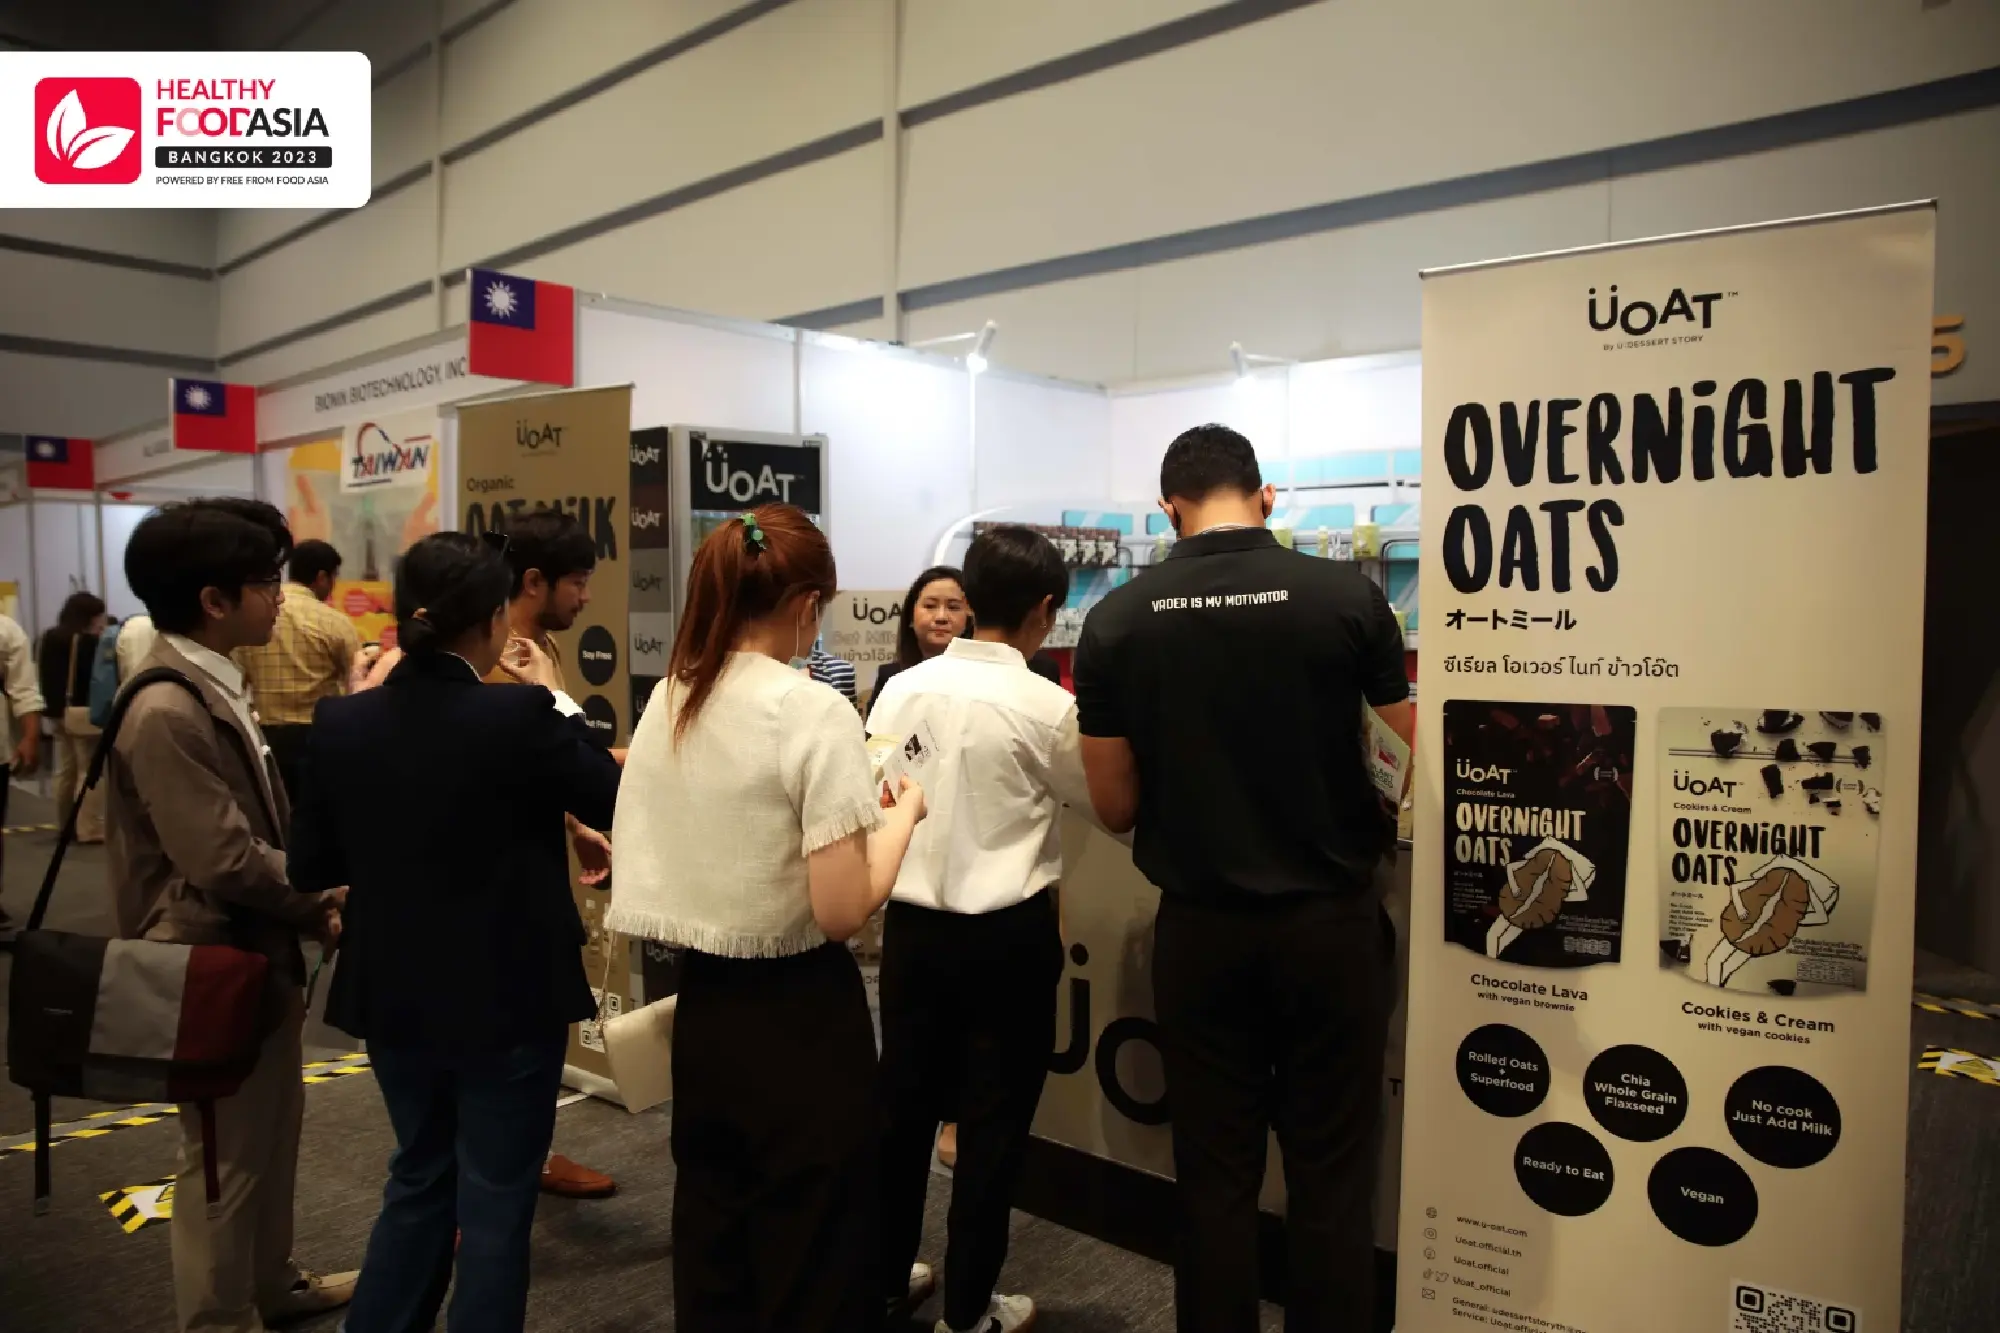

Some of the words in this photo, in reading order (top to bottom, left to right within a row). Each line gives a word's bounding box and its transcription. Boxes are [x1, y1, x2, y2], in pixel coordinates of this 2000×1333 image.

[1588, 284, 1723, 336] ÜOAT
[1602, 343, 1614, 351] By
[1672, 335, 1704, 345] STORY
[466, 476, 515, 493] Organic
[705, 451, 795, 503] ÜOAT
[1443, 498, 1624, 594] OATS
[852, 597, 902, 624] ÜOA
[1152, 597, 1188, 612] VADER
[1191, 597, 1203, 609] IS
[1206, 595, 1222, 608] MY
[1224, 589, 1289, 607] MOTIVATOR
[1445, 609, 1577, 630] オートミール
[1456, 788, 1495, 798] Chocolate
[1673, 769, 1737, 798] ÜOAT
[1673, 802, 1710, 812] Cookies
[1721, 805, 1752, 814] Cream
[1455, 834, 1512, 867] OATS
[1672, 852, 1737, 886] OATS
[1470, 973, 1547, 995] Chocolate
[1551, 984, 1588, 1001] Lava
[1477, 991, 1498, 1001] with
[1500, 993, 1531, 1006] vegan
[1533, 999, 1575, 1012] brownie
[1681, 1001, 1751, 1022] Cookies
[1756, 1011, 1768, 1024] &
[1774, 1013, 1835, 1033] Cream
[1698, 1021, 1722, 1032] with
[1726, 1026, 1761, 1038] vegan
[1764, 1031, 1811, 1044] cookies
[1468, 1051, 1507, 1066] Rolled
[1509, 1058, 1539, 1072] Oats
[1470, 1072, 1534, 1092] Superfood
[1621, 1073, 1650, 1087] Chia
[1594, 1081, 1637, 1098] Whole
[1641, 1090, 1677, 1104] Grain
[1604, 1096, 1664, 1115] Flaxseed
[1752, 1100, 1772, 1113] No
[1776, 1105, 1813, 1119] cook
[1732, 1110, 1762, 1124] Just
[1766, 1116, 1797, 1130] Add
[1802, 1121, 1832, 1136] Milk
[1523, 1156, 1562, 1174] Ready
[1565, 1165, 1579, 1176] to
[1583, 1168, 1605, 1182] Eat
[1681, 1186, 1724, 1204] Vegan
[1456, 1215, 1528, 1238] www.u-oat.com
[1452, 1297, 1490, 1312] General:
[1452, 1307, 1488, 1324] Service:
